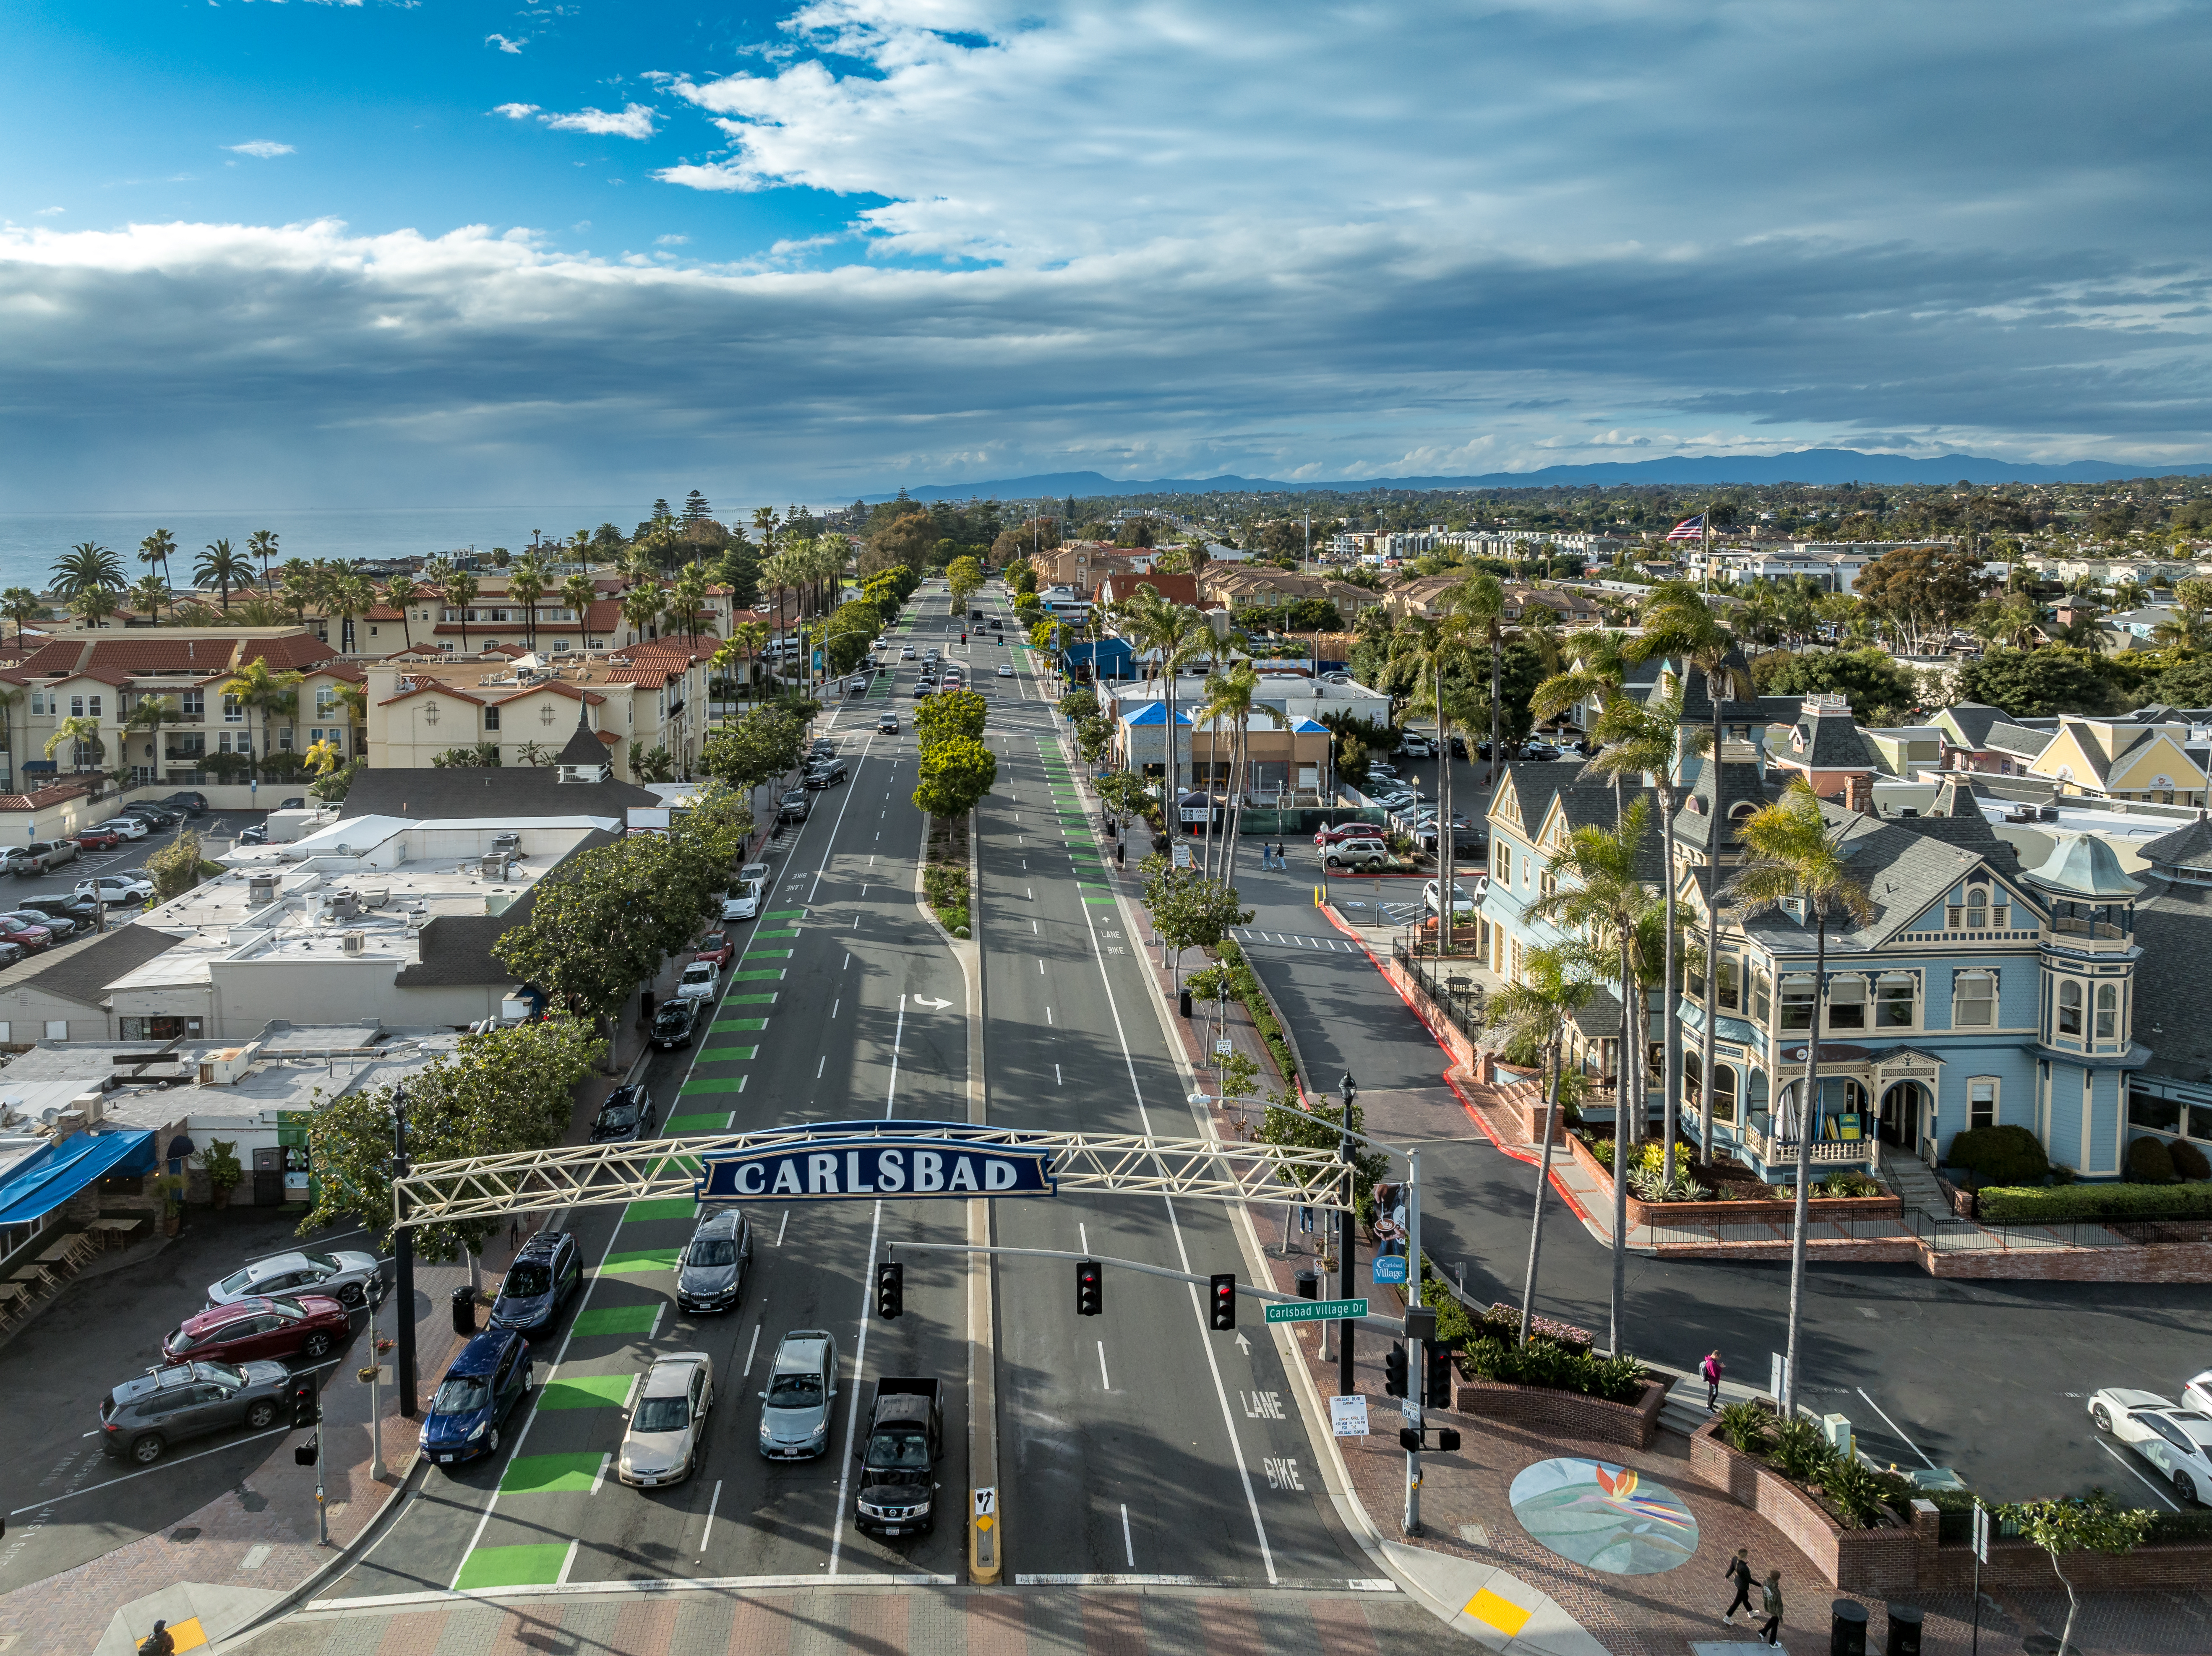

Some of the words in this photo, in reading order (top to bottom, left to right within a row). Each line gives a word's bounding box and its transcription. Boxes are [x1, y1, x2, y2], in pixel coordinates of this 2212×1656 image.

[1107, 946, 1125, 955] BIKE
[734, 1150, 1018, 1195] CARLSBAD
[1375, 1268, 1403, 1279] Village
[1270, 1302, 1311, 1318] Carlsbad
[1316, 1303, 1349, 1315] Village
[1353, 1302, 1363, 1312] Dr
[1239, 1390, 1286, 1419] LANE
[1404, 1409, 1412, 1419] OK
[1263, 1458, 1305, 1490] BIKE
